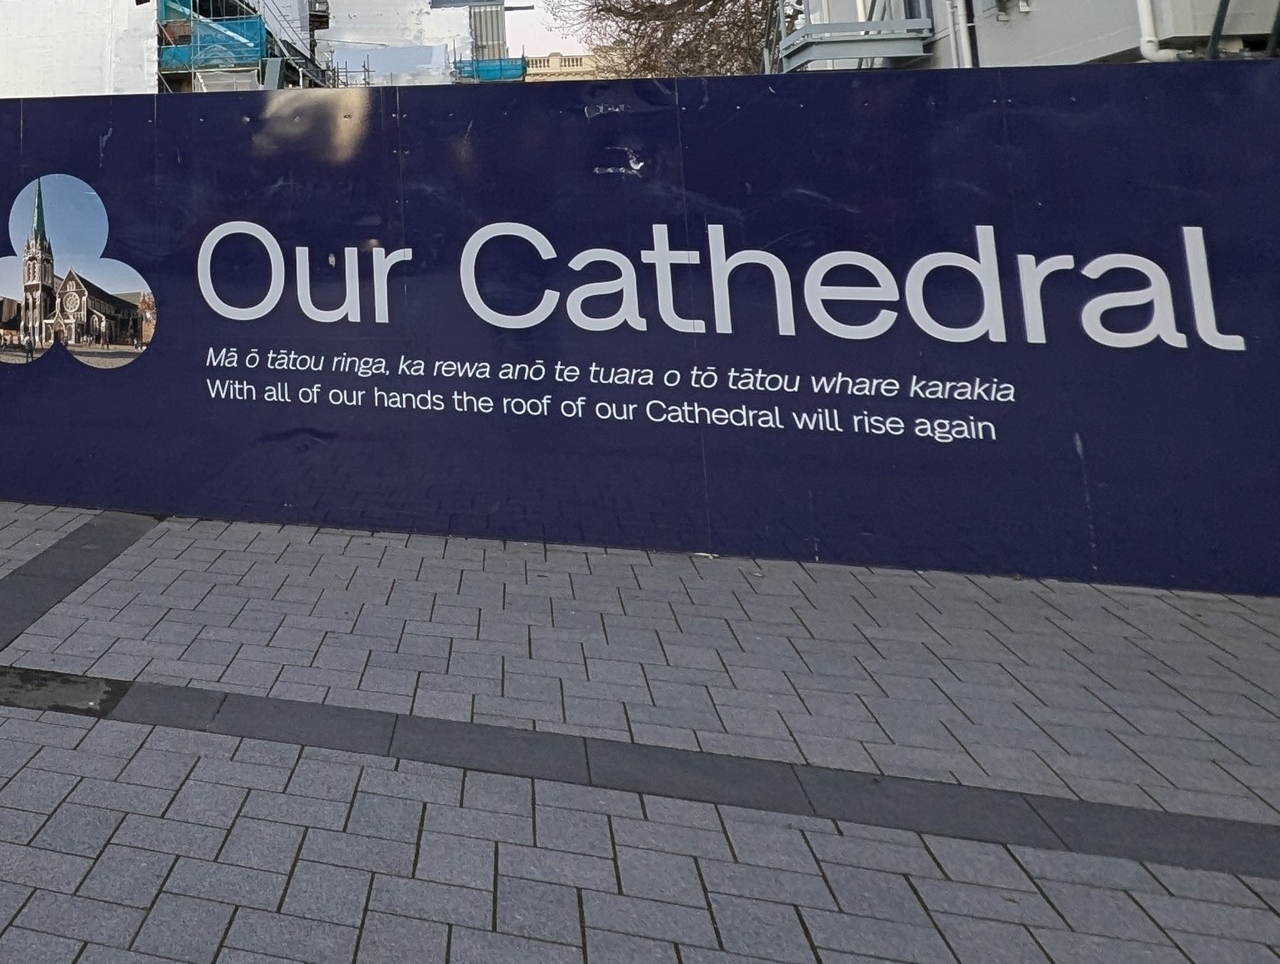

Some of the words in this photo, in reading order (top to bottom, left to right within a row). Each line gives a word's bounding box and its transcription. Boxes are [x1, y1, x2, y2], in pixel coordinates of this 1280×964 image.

[197, 220, 413, 324] Our
[459, 221, 1246, 351] Cathedral
[205, 346, 238, 368] Mā
[245, 348, 260, 369] ō
[267, 349, 325, 371] tātou
[331, 351, 391, 378] ringa,
[397, 354, 425, 376] ka
[433, 359, 491, 379] rewa
[498, 359, 546, 381] anō
[554, 360, 581, 383] te
[588, 362, 654, 386] tuara
[663, 369, 681, 387] o
[690, 365, 718, 389] tō
[727, 367, 801, 393] tātou
[810, 371, 900, 397] whare
[909, 374, 1016, 402] karakia
[206, 378, 256, 401] With
[263, 381, 292, 403] all
[298, 383, 322, 404] of
[328, 388, 367, 406] our
[374, 386, 445, 411] hands
[451, 390, 494, 414] the
[502, 394, 552, 416] roof
[560, 396, 587, 418] of
[595, 402, 638, 421] our
[645, 399, 784, 429] Cathedral
[791, 405, 844, 432] will
[852, 410, 905, 436] rise
[914, 415, 997, 443] again
